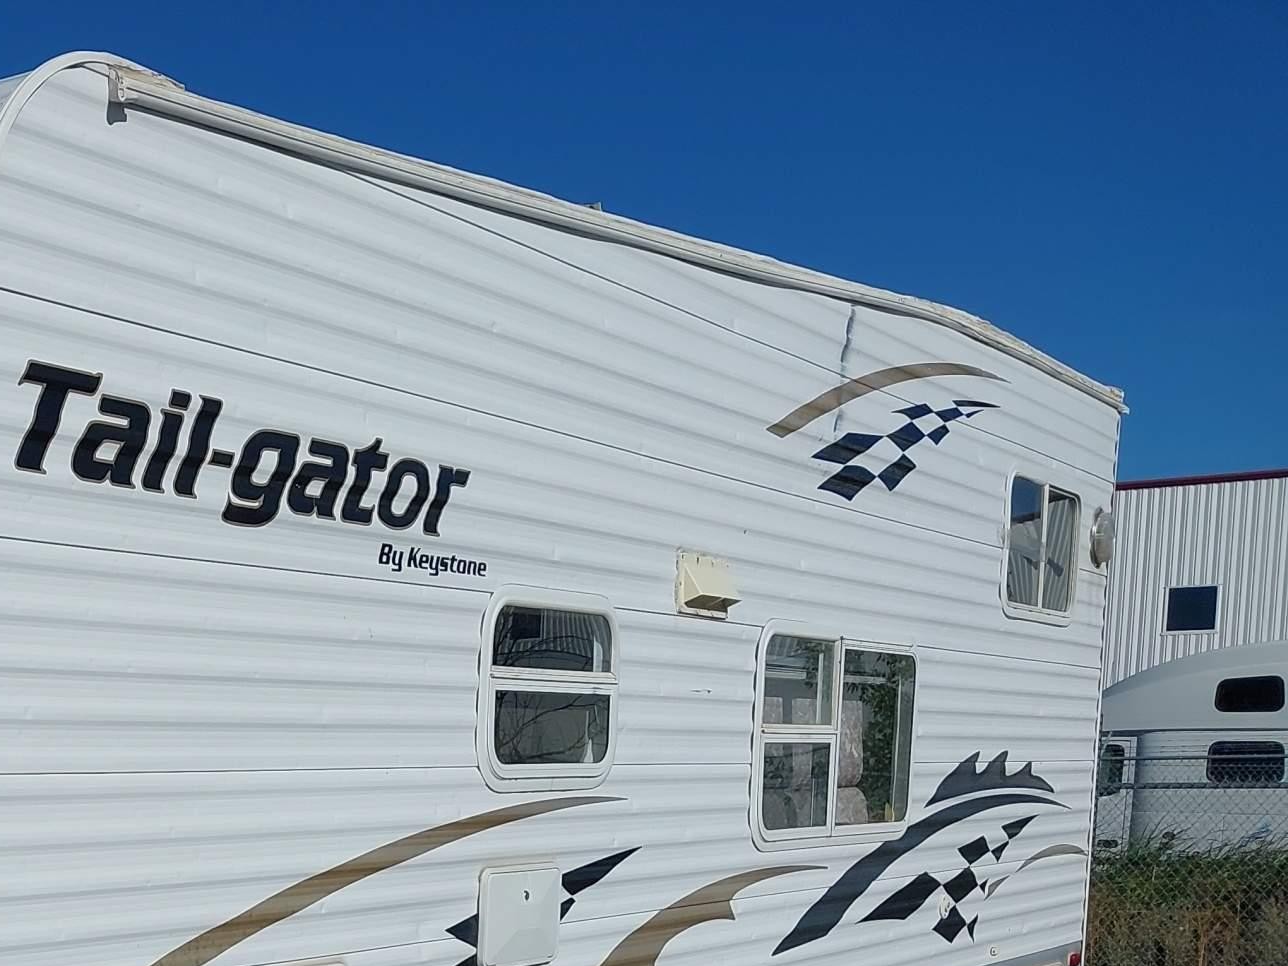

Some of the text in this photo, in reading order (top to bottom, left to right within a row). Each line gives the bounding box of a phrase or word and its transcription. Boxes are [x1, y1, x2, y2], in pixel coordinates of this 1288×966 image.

[14, 358, 471, 537] Tail-gator
[378, 542, 488, 577] By Keystone
